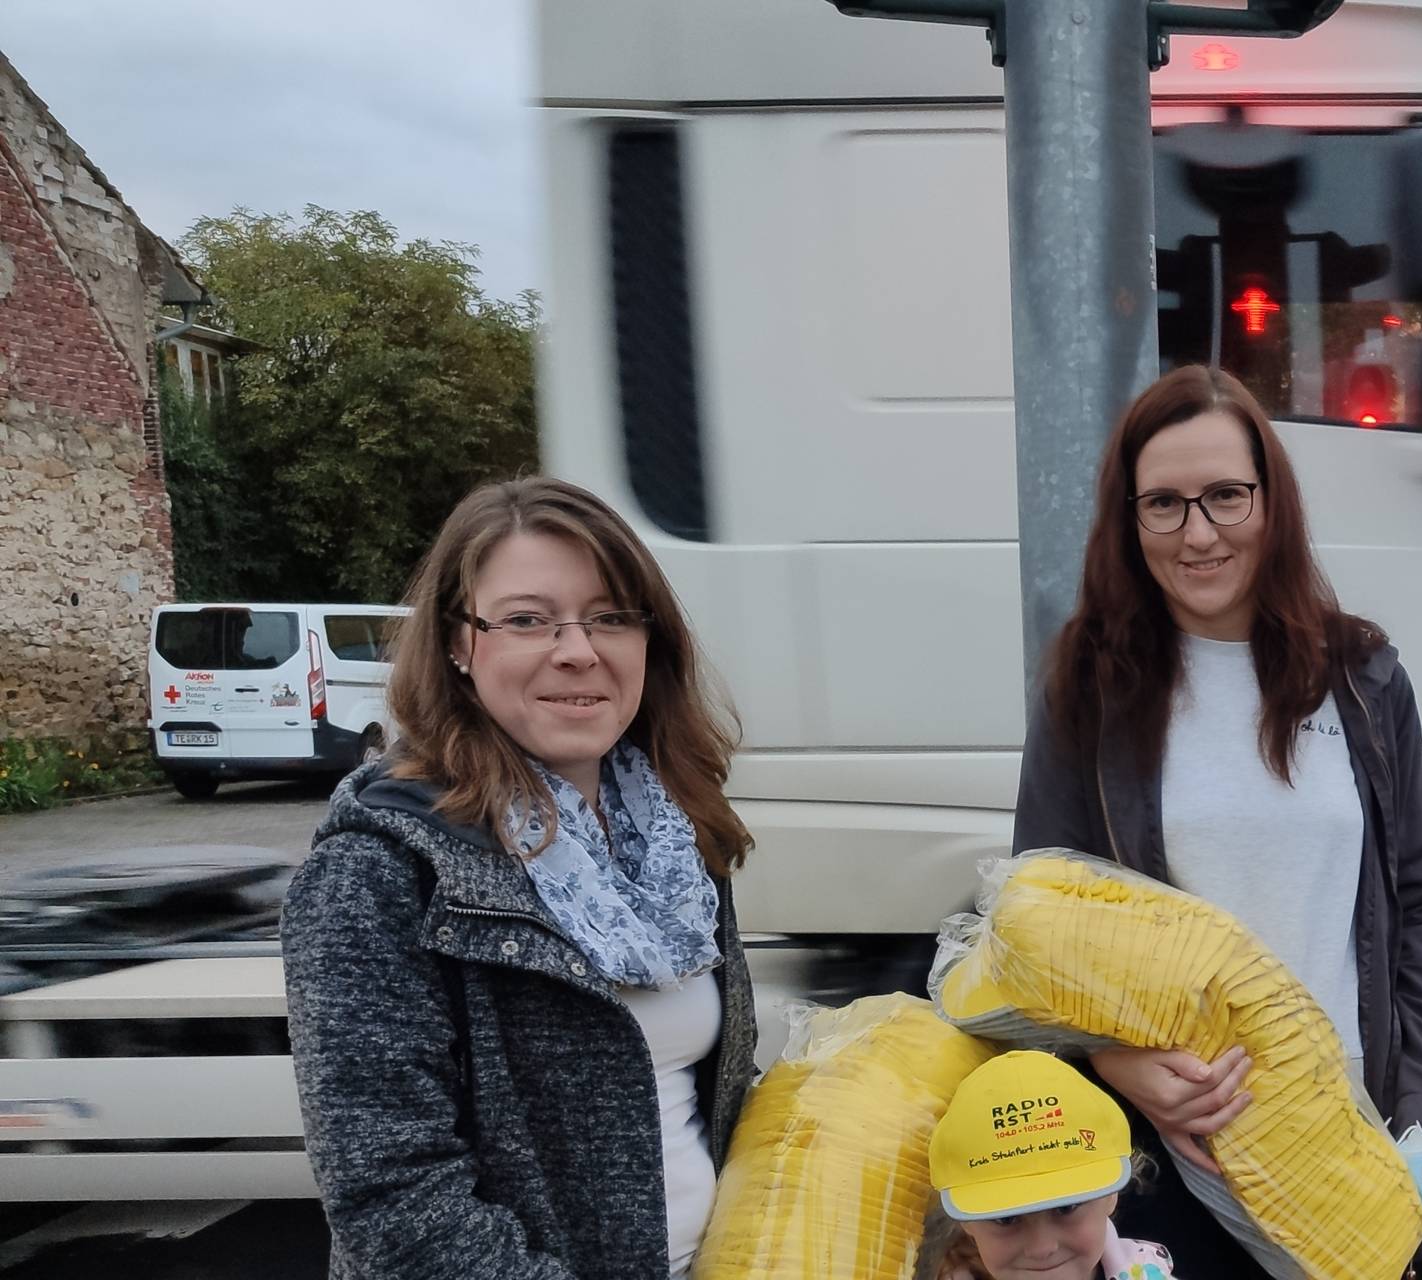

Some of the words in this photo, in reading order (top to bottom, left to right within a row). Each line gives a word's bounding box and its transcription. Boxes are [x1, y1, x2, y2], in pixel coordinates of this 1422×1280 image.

[992, 1096, 1059, 1118] RADIO
[993, 1112, 1032, 1130] RST
[1047, 1121, 1065, 1129] MHz
